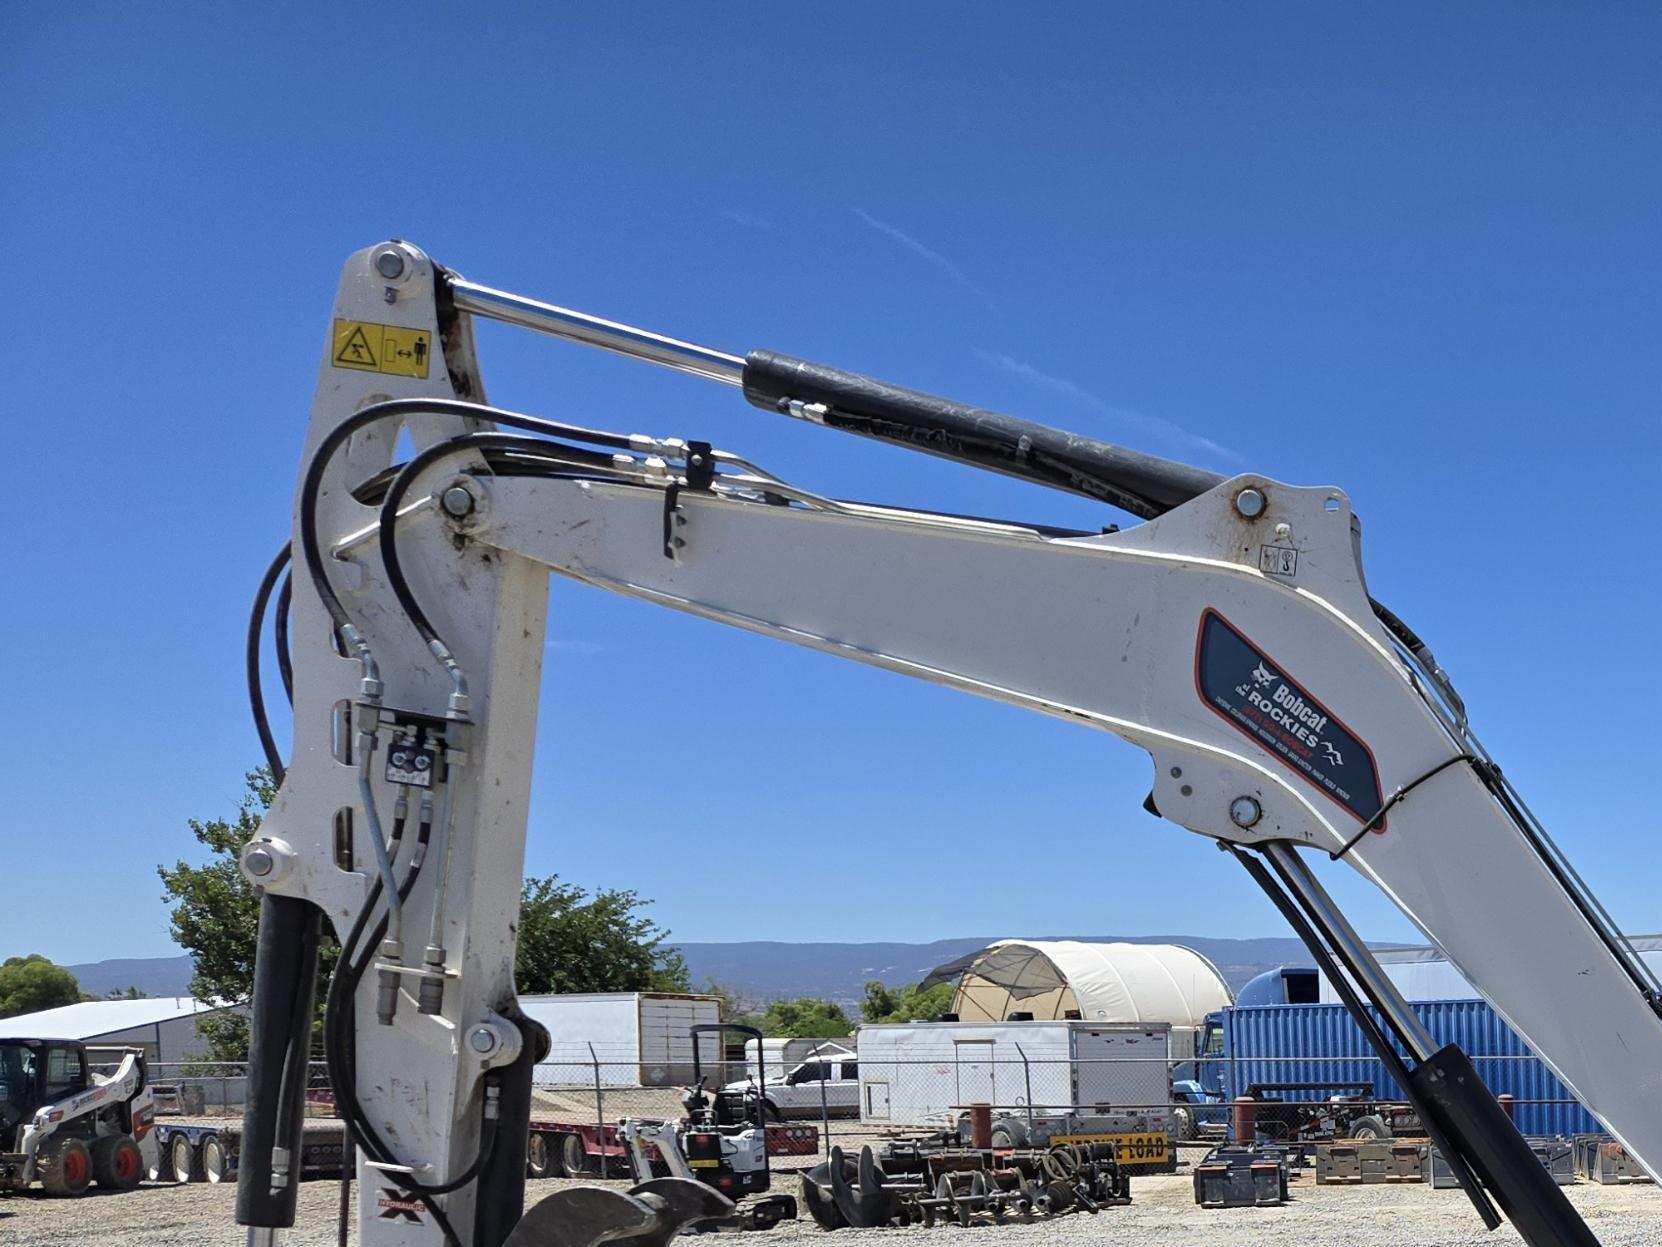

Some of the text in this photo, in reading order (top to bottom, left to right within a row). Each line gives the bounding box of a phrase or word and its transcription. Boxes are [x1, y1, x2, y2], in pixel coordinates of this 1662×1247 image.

[1248, 690, 1319, 748] ROCKIES
[1273, 684, 1328, 733] Bobcat
[1128, 1136, 1165, 1159] LOAD
